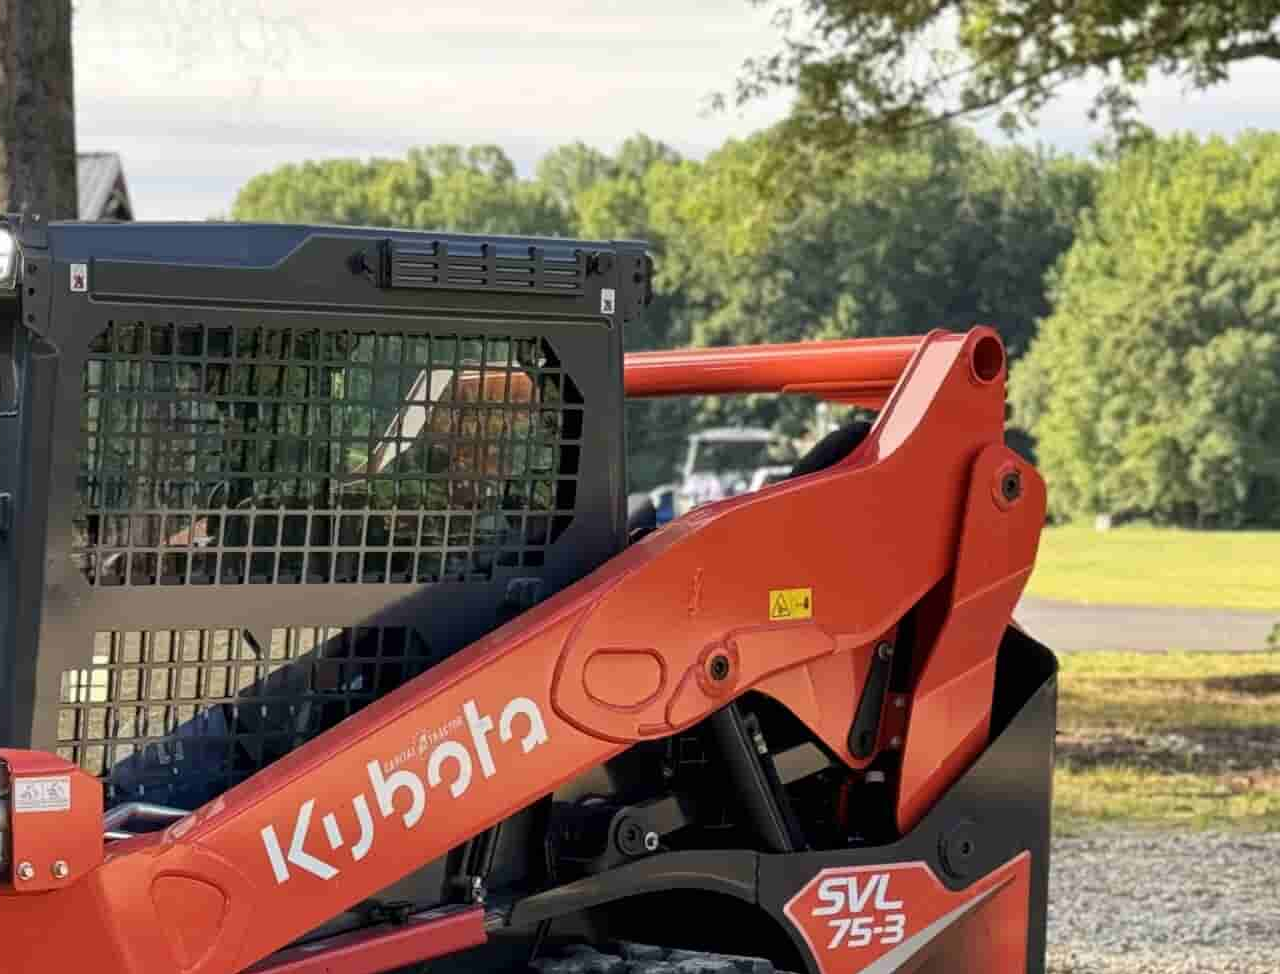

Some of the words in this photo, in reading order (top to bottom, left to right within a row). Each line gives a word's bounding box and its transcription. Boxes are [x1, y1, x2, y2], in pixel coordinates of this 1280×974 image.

[260, 697, 549, 885] Kubota
[812, 874, 904, 916] SVL
[827, 914, 906, 949] 75-3
